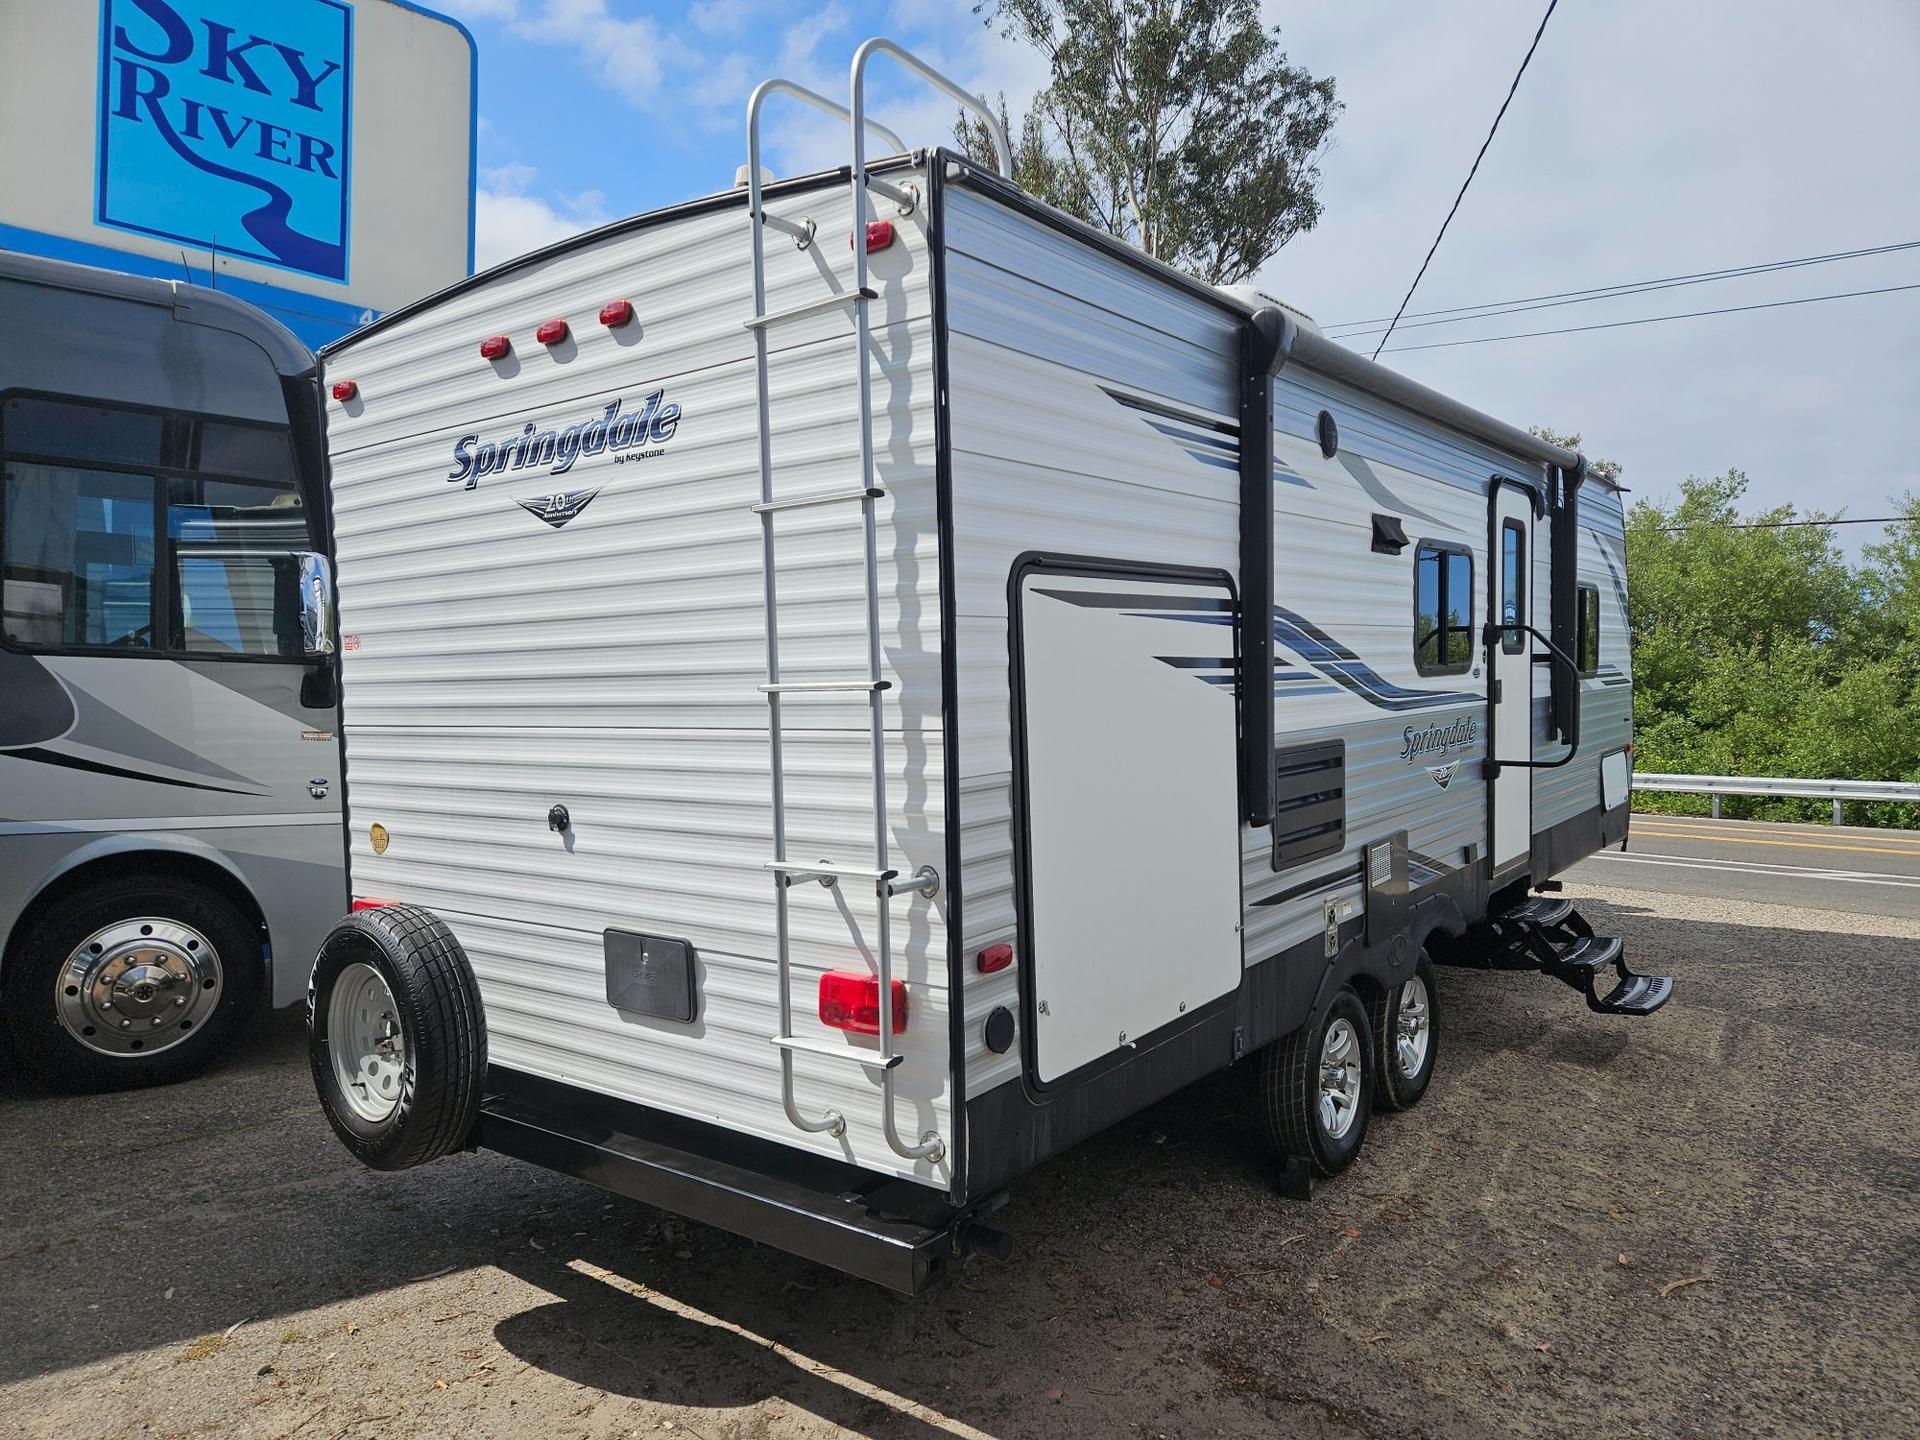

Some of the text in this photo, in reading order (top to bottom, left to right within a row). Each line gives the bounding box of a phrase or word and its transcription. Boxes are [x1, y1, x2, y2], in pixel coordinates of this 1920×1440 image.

[114, 0, 341, 112] SKY
[112, 56, 339, 180] RIVER
[447, 389, 682, 490] Springdale
[614, 454, 625, 464] by
[1399, 714, 1478, 766] Springdale
